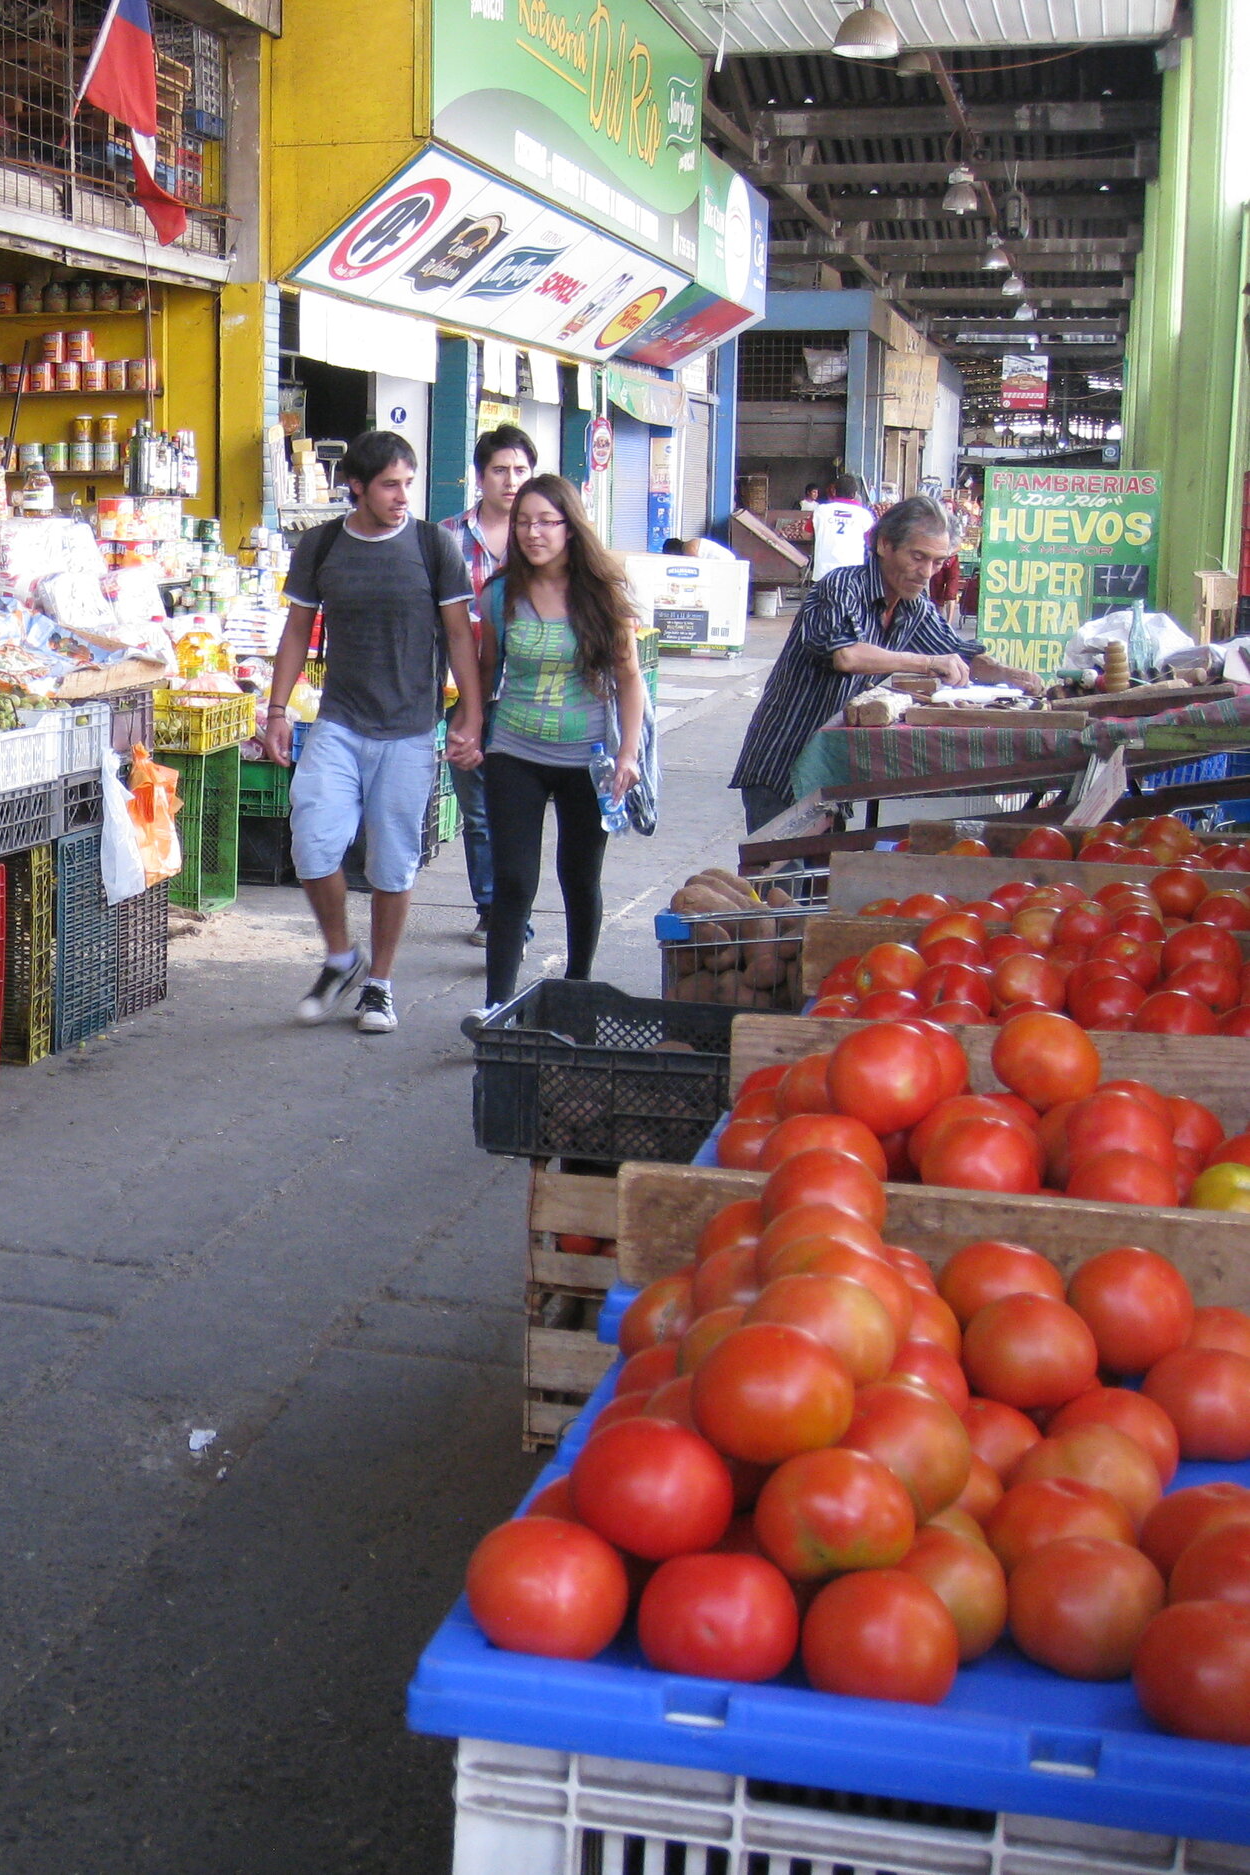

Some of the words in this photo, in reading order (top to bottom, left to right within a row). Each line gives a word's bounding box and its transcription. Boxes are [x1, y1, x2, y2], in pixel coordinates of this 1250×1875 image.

[350, 196, 432, 264] PF
[534, 271, 588, 305] SOPROLE
[992, 472, 1157, 495] FIAMBRERIAS
[989, 507, 1153, 546] HUEVOS
[1039, 544, 1114, 556] MAYOR
[985, 559, 1085, 597] SUPER
[984, 598, 1081, 635] EXTRA
[983, 636, 1068, 674] PRIMER
